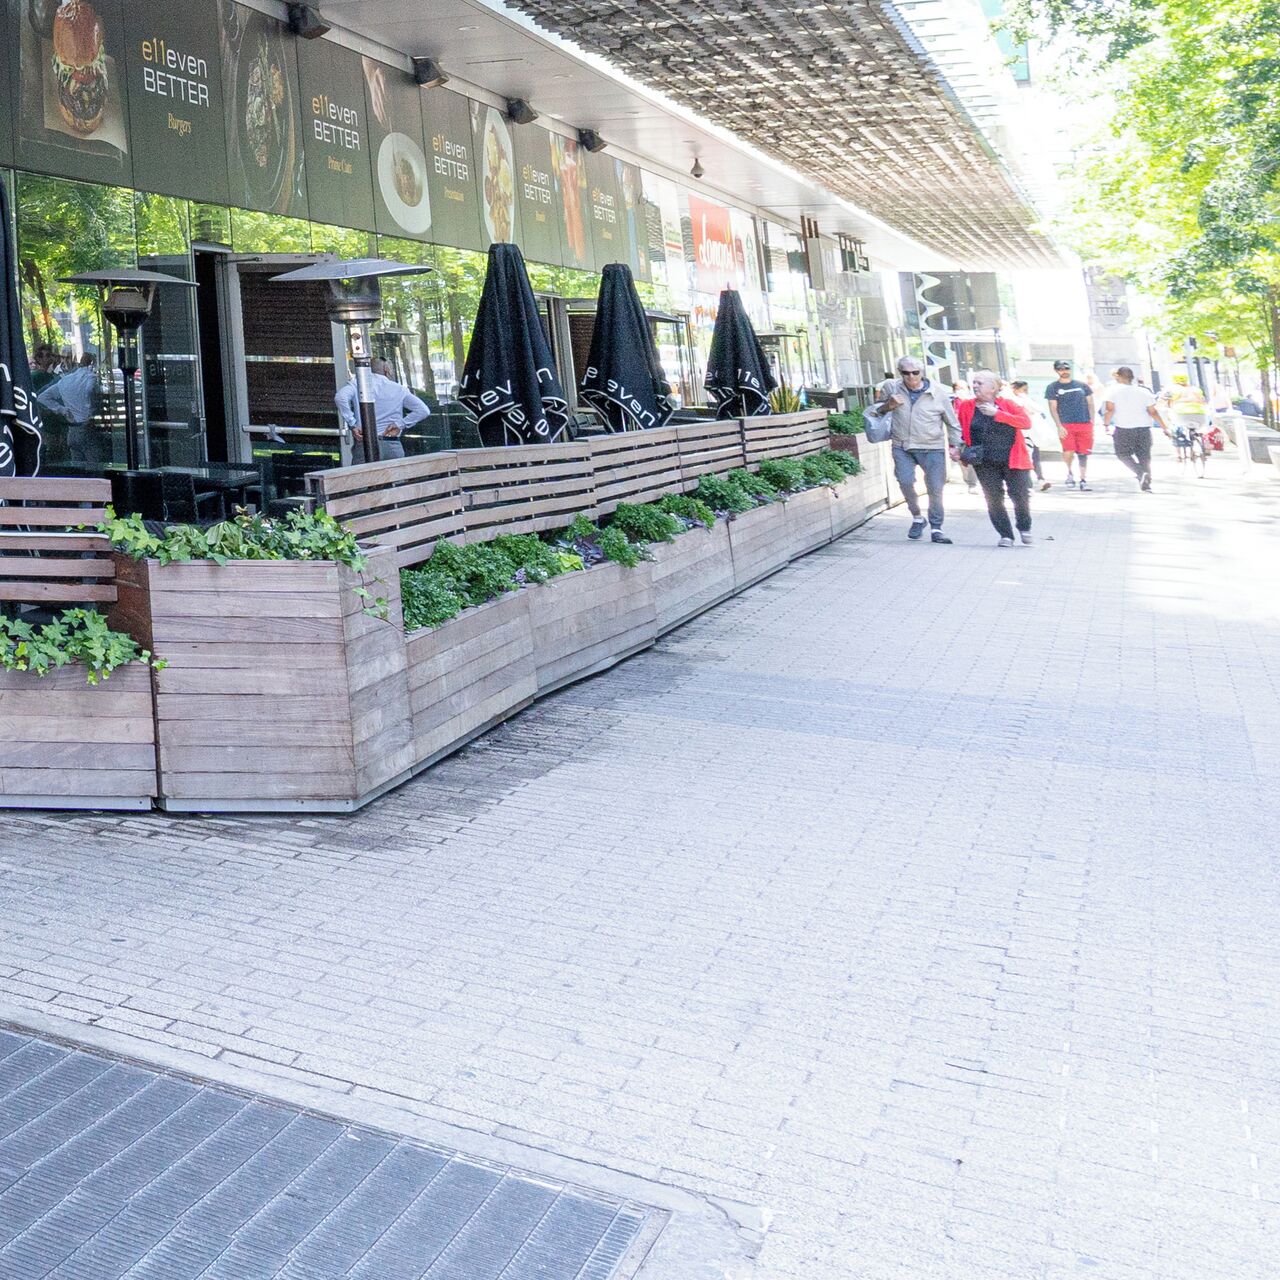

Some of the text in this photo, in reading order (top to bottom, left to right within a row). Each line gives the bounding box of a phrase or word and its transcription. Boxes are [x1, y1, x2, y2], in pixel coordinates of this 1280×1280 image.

[143, 66, 210, 108] BETTER
[167, 112, 192, 136] Burgers
[313, 119, 361, 151] BETTER
[434, 155, 470, 182] BETTER
[523, 183, 552, 205] BETTER
